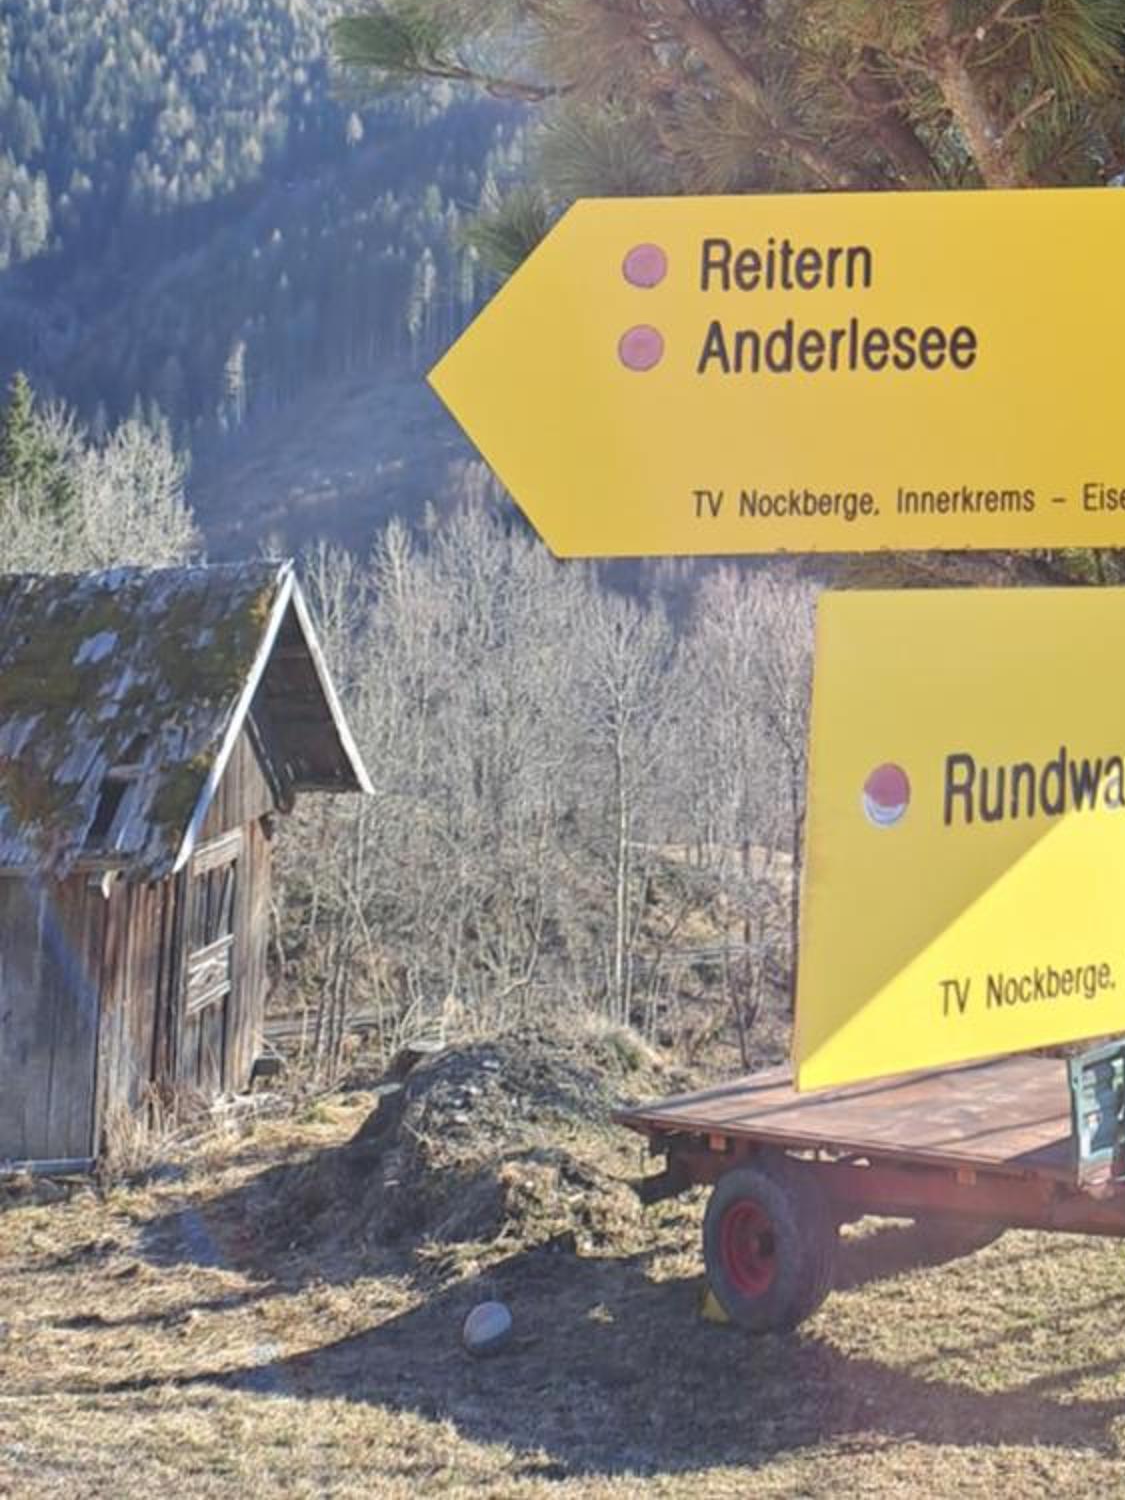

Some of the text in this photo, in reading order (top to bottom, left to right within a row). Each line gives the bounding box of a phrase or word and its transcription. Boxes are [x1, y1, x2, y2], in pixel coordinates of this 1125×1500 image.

[701, 237, 873, 292] Reitern
[697, 317, 978, 374] Anderlesee
[692, 489, 724, 517] TV
[897, 486, 1035, 514] Innerkrems
[939, 977, 971, 1017] TV
